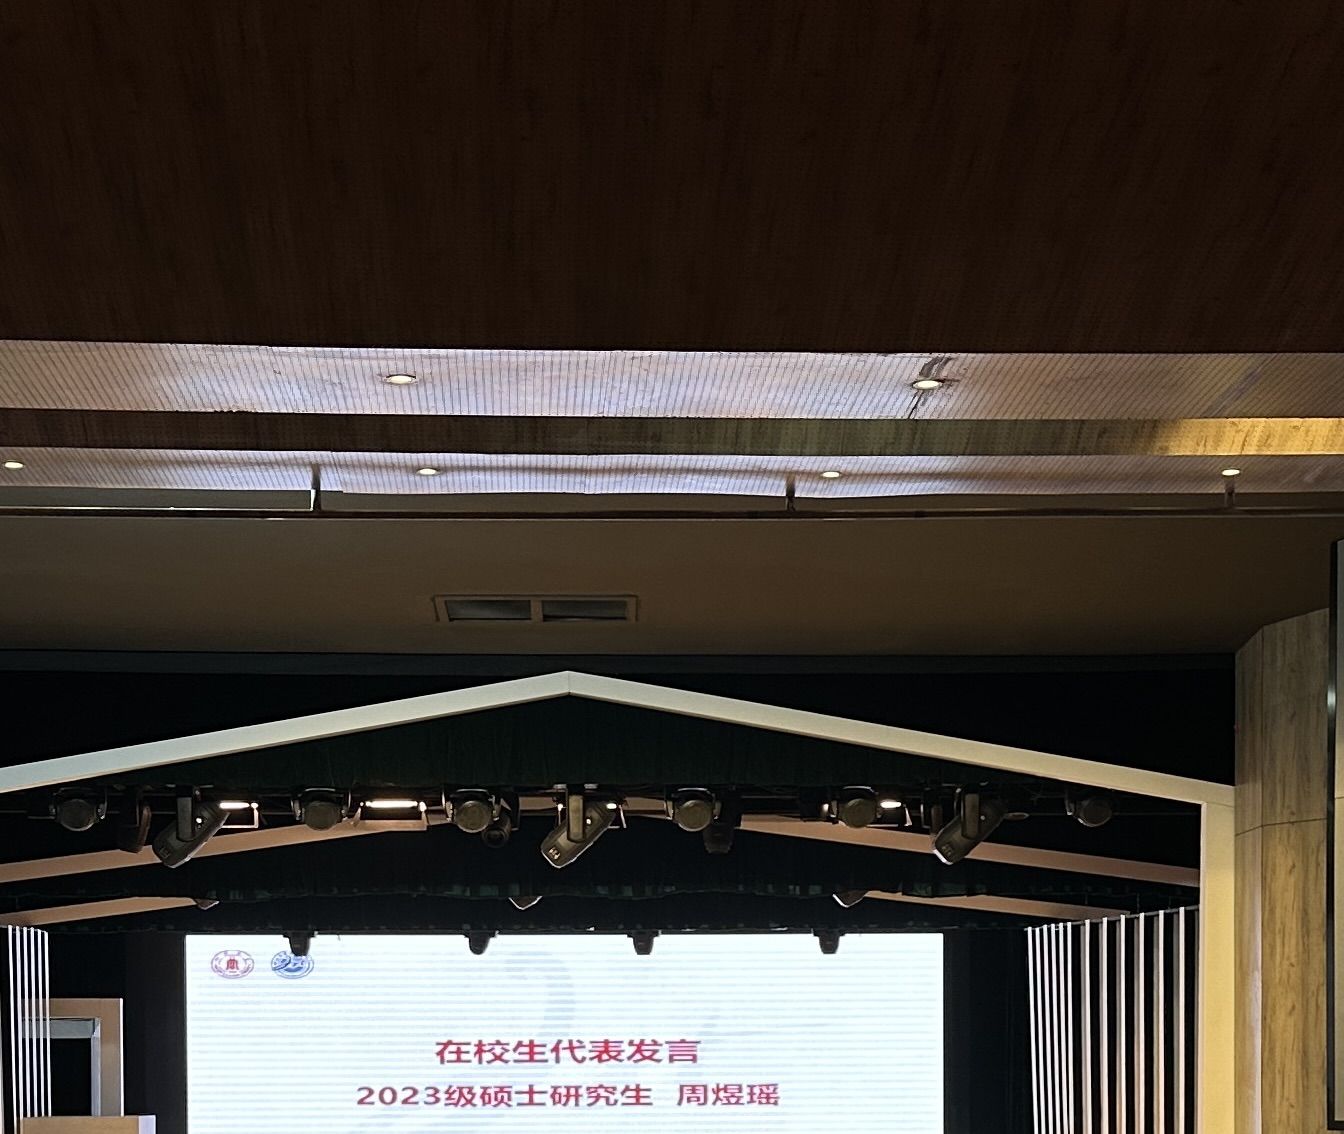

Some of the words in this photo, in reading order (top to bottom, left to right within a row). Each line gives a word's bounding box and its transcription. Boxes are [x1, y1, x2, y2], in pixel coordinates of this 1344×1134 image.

[435, 1038, 701, 1065] 在校生代表发言
[356, 1083, 654, 1108] 2023级硕士研究生
[676, 1083, 780, 1107] 周煜瑶
